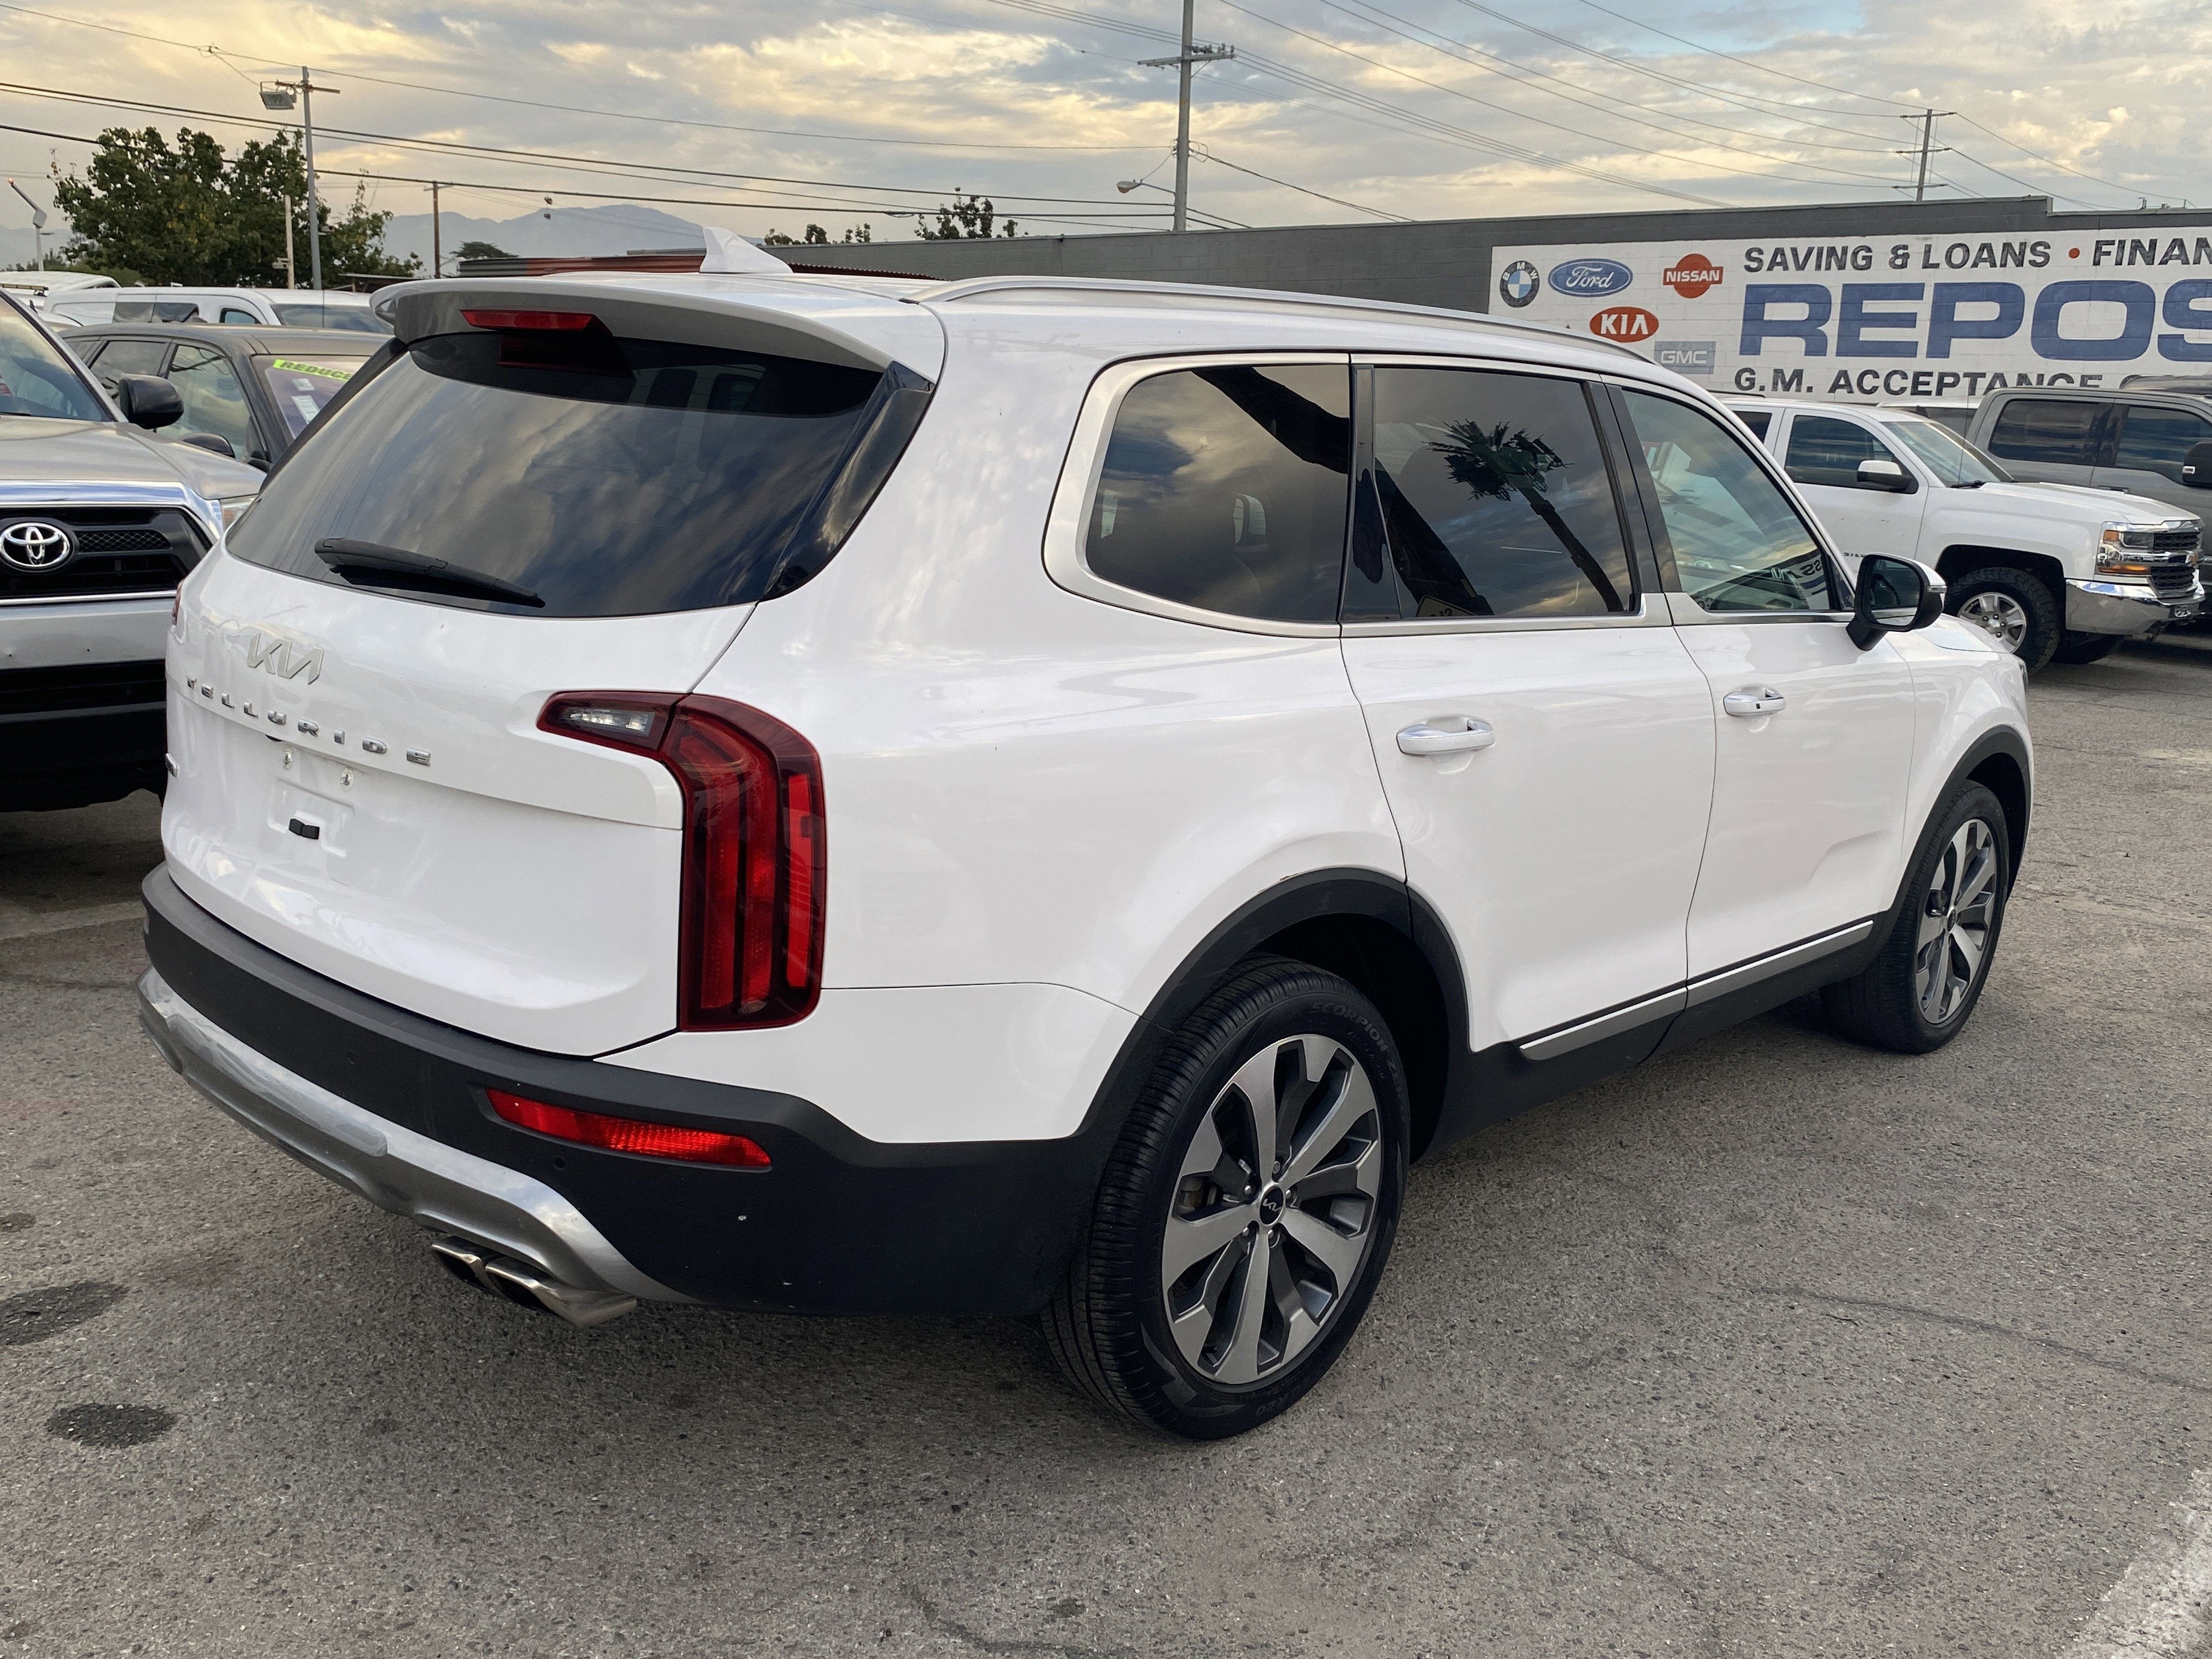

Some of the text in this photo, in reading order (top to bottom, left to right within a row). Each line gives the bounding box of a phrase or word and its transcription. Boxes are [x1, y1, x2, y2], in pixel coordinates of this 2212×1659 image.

[1743, 245, 1873, 272] SAVING
[1888, 244, 1910, 268] &
[1921, 240, 2051, 269] LOANS
[1565, 266, 1614, 289] Ford
[1665, 270, 1720, 283] NISSAN
[1600, 313, 1649, 335] KIA
[1660, 350, 1708, 365] GMC
[1734, 367, 1813, 393] G.M.
[1827, 369, 2103, 397] ACCEPTANCE
[246, 632, 324, 685] KIA
[185, 675, 432, 768] TELLURIDE
[1309, 1002, 1389, 1053] SCORPION
